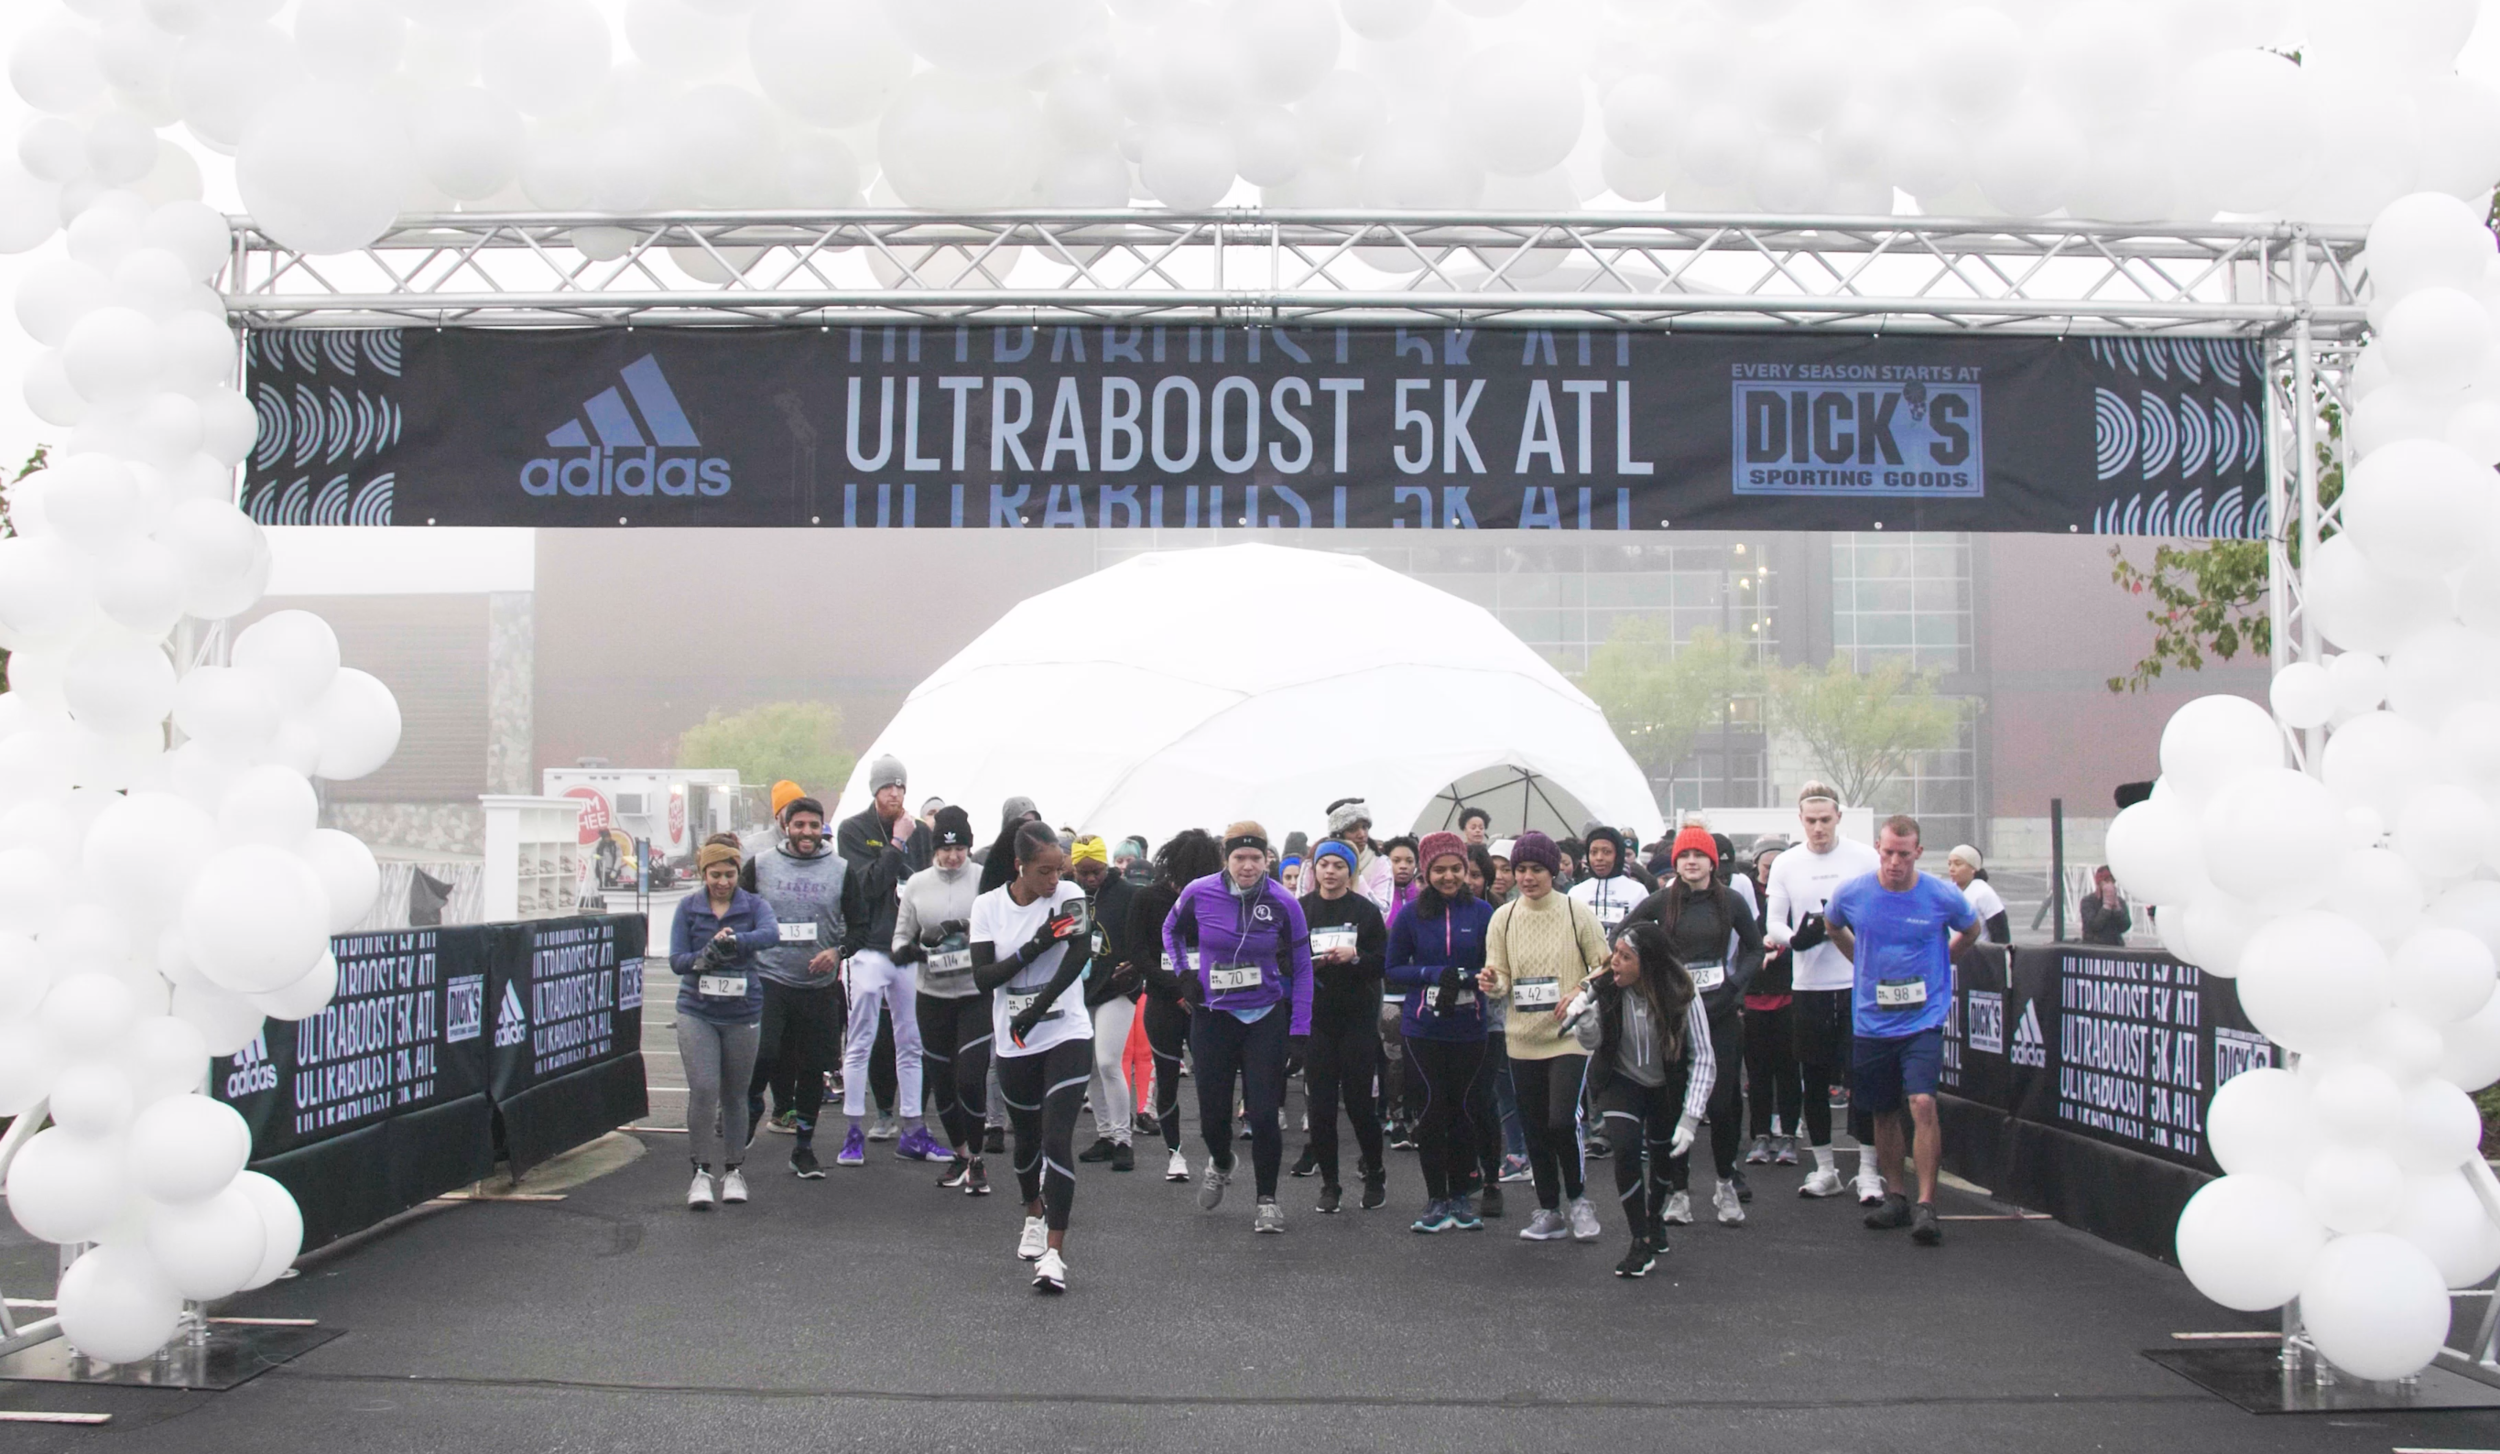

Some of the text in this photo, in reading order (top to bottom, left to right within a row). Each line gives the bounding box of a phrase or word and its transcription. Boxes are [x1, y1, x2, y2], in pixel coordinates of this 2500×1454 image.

[1732, 364, 1981, 381] EVERY SEASON STARTS AT
[845, 375, 1654, 475] ULTRABOOST 5K ATL
[1746, 382, 1970, 466] DICK'S
[520, 447, 732, 497] adidas
[1750, 469, 1969, 488] SPORTING GOODS
[790, 925, 801, 938] 13
[718, 979, 729, 993] 12
[1228, 970, 1243, 985] 70
[533, 974, 586, 1026] ULTRABOOST
[598, 970, 614, 1008] ATL
[1528, 987, 1542, 1001] 42
[1894, 987, 1909, 1001] 98
[297, 990, 438, 1066] ULTRABOOST 5K ATL
[2061, 1013, 2202, 1091] ULTRABOOST 5K ATL
[227, 1060, 278, 1099] adidas
